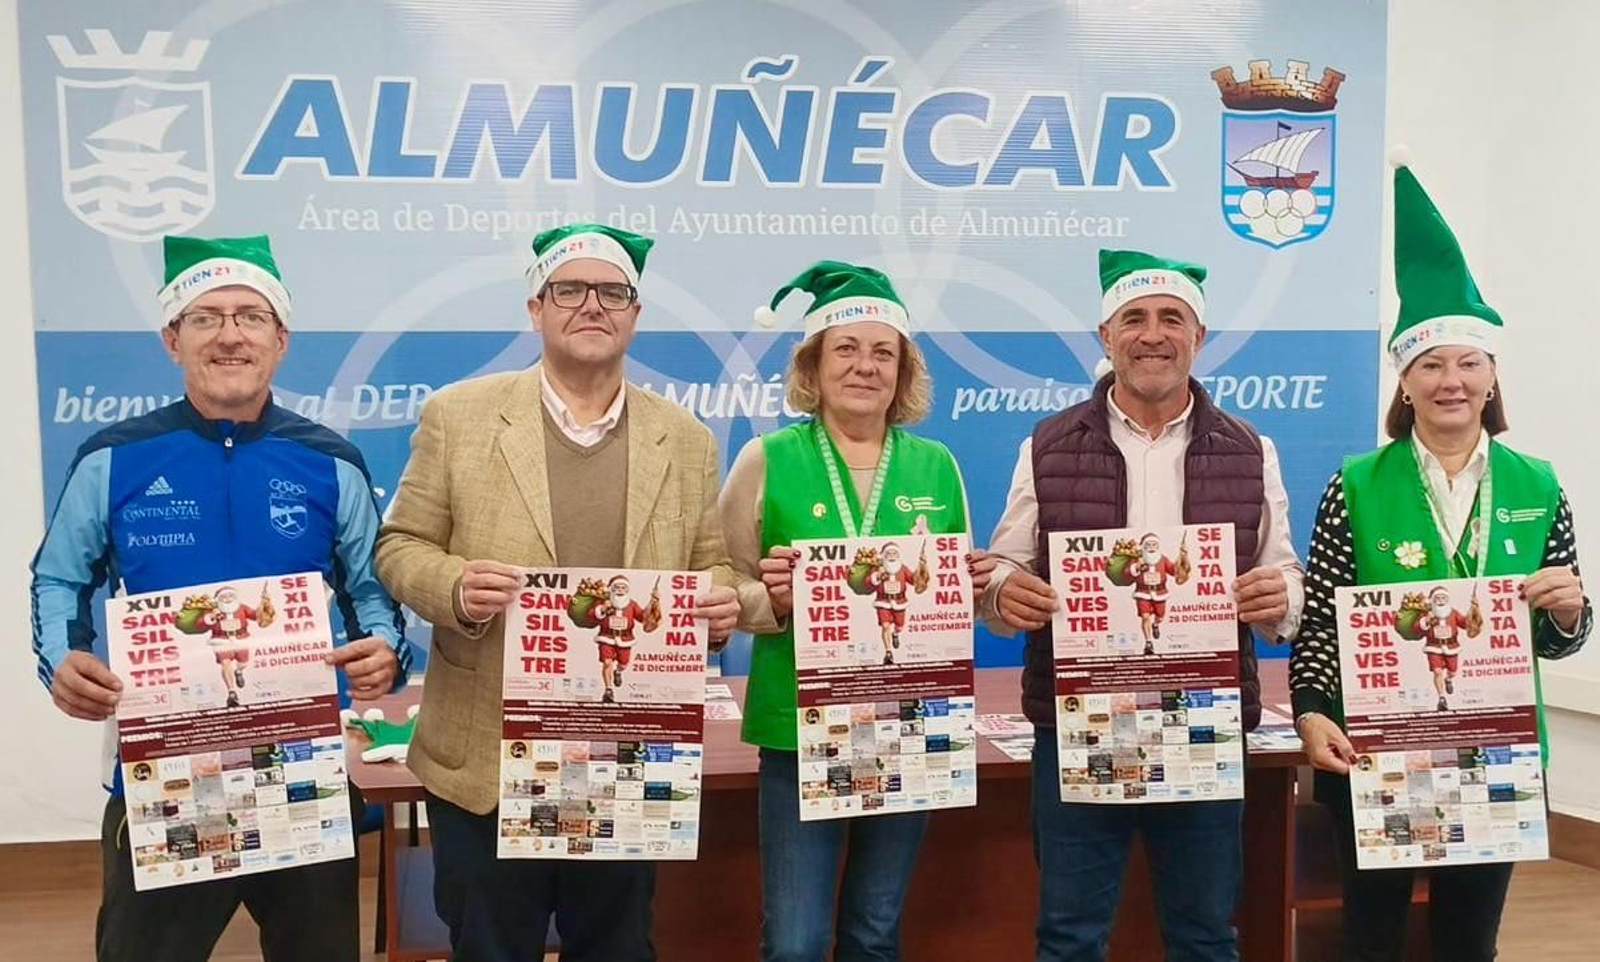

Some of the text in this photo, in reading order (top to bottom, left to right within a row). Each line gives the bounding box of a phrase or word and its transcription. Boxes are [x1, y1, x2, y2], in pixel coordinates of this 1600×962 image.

[235, 56, 1181, 193] ALMUÑÉCAR
[298, 195, 1129, 241] Área de Deportes del Ayuntamiento de Almuñécar
[297, 387, 336, 421] al
[351, 383, 433, 421] DEP
[952, 378, 1088, 420] paraiso
[1198, 528, 1221, 542] SE
[936, 538, 958, 551] SE
[1066, 536, 1103, 553] XVI
[1200, 546, 1219, 559] XI
[809, 545, 846, 561] XVI
[939, 555, 957, 569] XI
[1062, 556, 1108, 574] SAN
[805, 565, 850, 583] SAN
[1198, 564, 1223, 577] TA
[280, 576, 307, 589] SE
[524, 573, 568, 589] XVI
[672, 575, 697, 590] SE
[937, 573, 960, 586] TA
[1070, 577, 1104, 593] SIL
[1489, 580, 1514, 594] SE
[812, 586, 845, 602] SIL
[1197, 582, 1226, 595] NA
[127, 595, 172, 613] XVI
[285, 592, 307, 604] XI
[520, 592, 571, 611] SAN
[672, 595, 696, 609] XI
[936, 591, 963, 605] NA
[1066, 596, 1108, 612] VES
[1353, 591, 1391, 608] XVI
[1492, 598, 1512, 612] XI
[122, 611, 176, 630] SAN
[284, 606, 313, 619] TA
[669, 612, 696, 627] TA
[808, 606, 849, 622] VES
[1350, 611, 1396, 629] SAN
[526, 614, 565, 631] SIL
[1067, 616, 1108, 632] TRE
[1490, 616, 1516, 630] TA
[131, 629, 174, 646] SIL
[666, 632, 696, 646] NA
[809, 626, 849, 642] TRE
[1358, 632, 1393, 648] SIL
[1490, 634, 1520, 649] NA
[521, 636, 567, 653] VES
[128, 646, 179, 665] VES
[1355, 651, 1398, 668] VES
[521, 657, 566, 674] TRE
[130, 666, 182, 687] TRE
[1357, 672, 1400, 689] TRE
